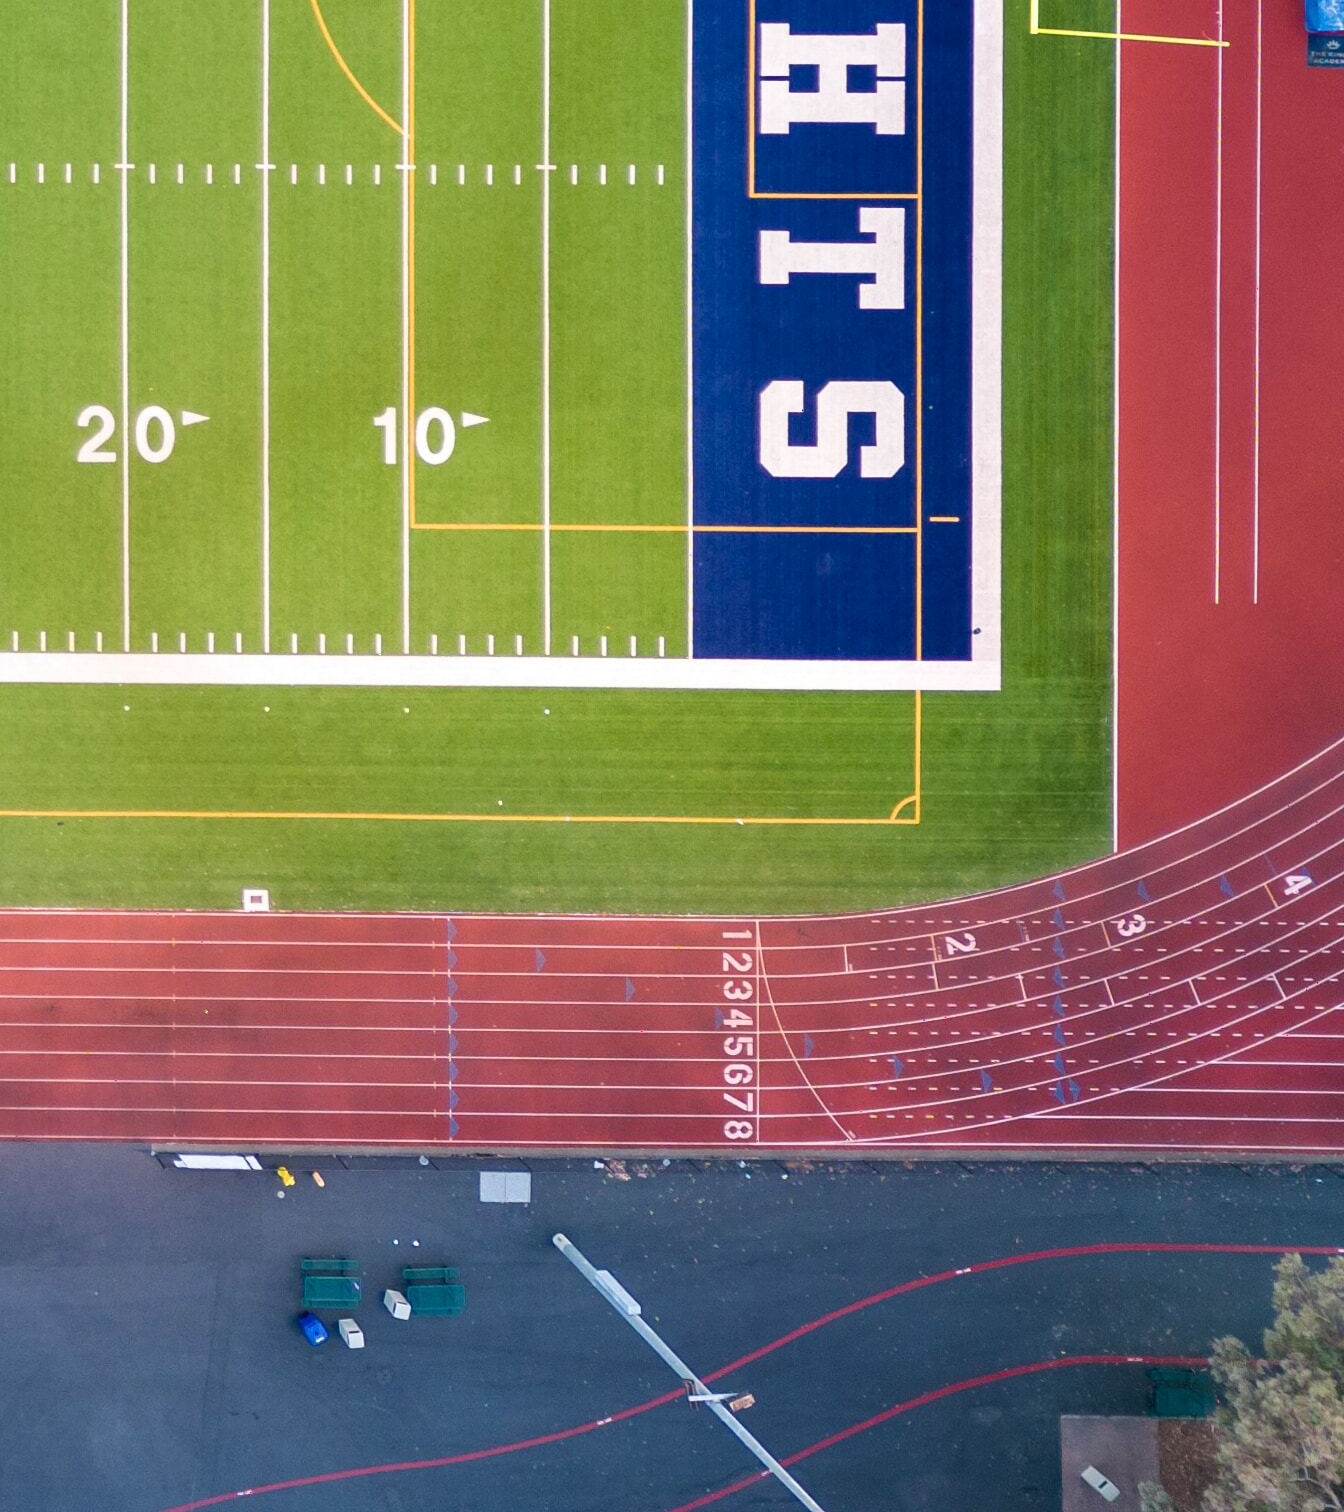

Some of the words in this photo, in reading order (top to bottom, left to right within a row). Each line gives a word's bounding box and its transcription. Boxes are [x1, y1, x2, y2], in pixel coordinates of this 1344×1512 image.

[76, 405, 176, 464] 20
[373, 406, 456, 465] 10
[1283, 875, 1313, 896] 4
[722, 929, 753, 939] 1
[1117, 914, 1147, 937] 3
[944, 933, 977, 955] 2
[722, 952, 753, 972] 2
[723, 980, 753, 1000] 3
[723, 1008, 753, 1028] 4
[723, 1036, 753, 1056] 5
[723, 1064, 753, 1085] 6
[723, 1092, 753, 1112] 7
[723, 1120, 753, 1140] 8
